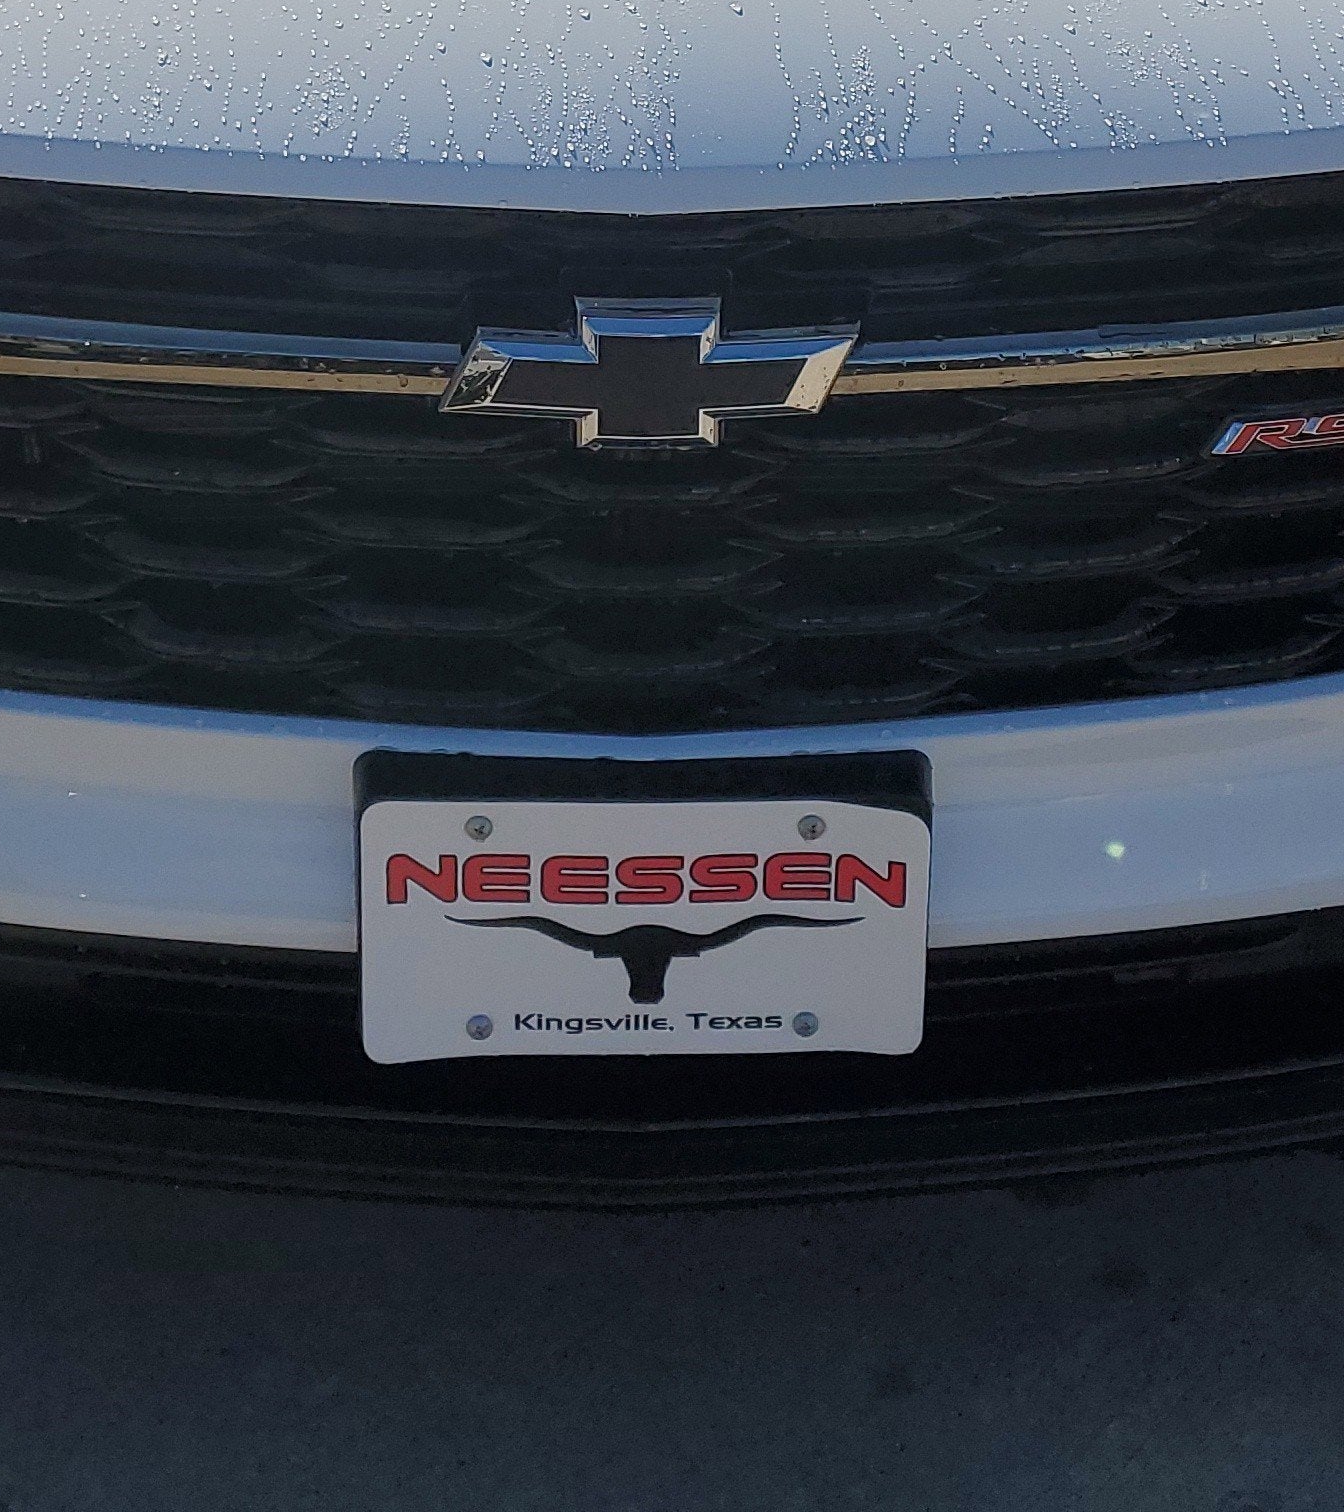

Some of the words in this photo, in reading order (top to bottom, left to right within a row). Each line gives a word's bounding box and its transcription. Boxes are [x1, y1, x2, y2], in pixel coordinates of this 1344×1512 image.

[386, 852, 907, 909] NEESSEN
[514, 1012, 675, 1035] Kingsville,
[685, 1012, 784, 1030] Texas
